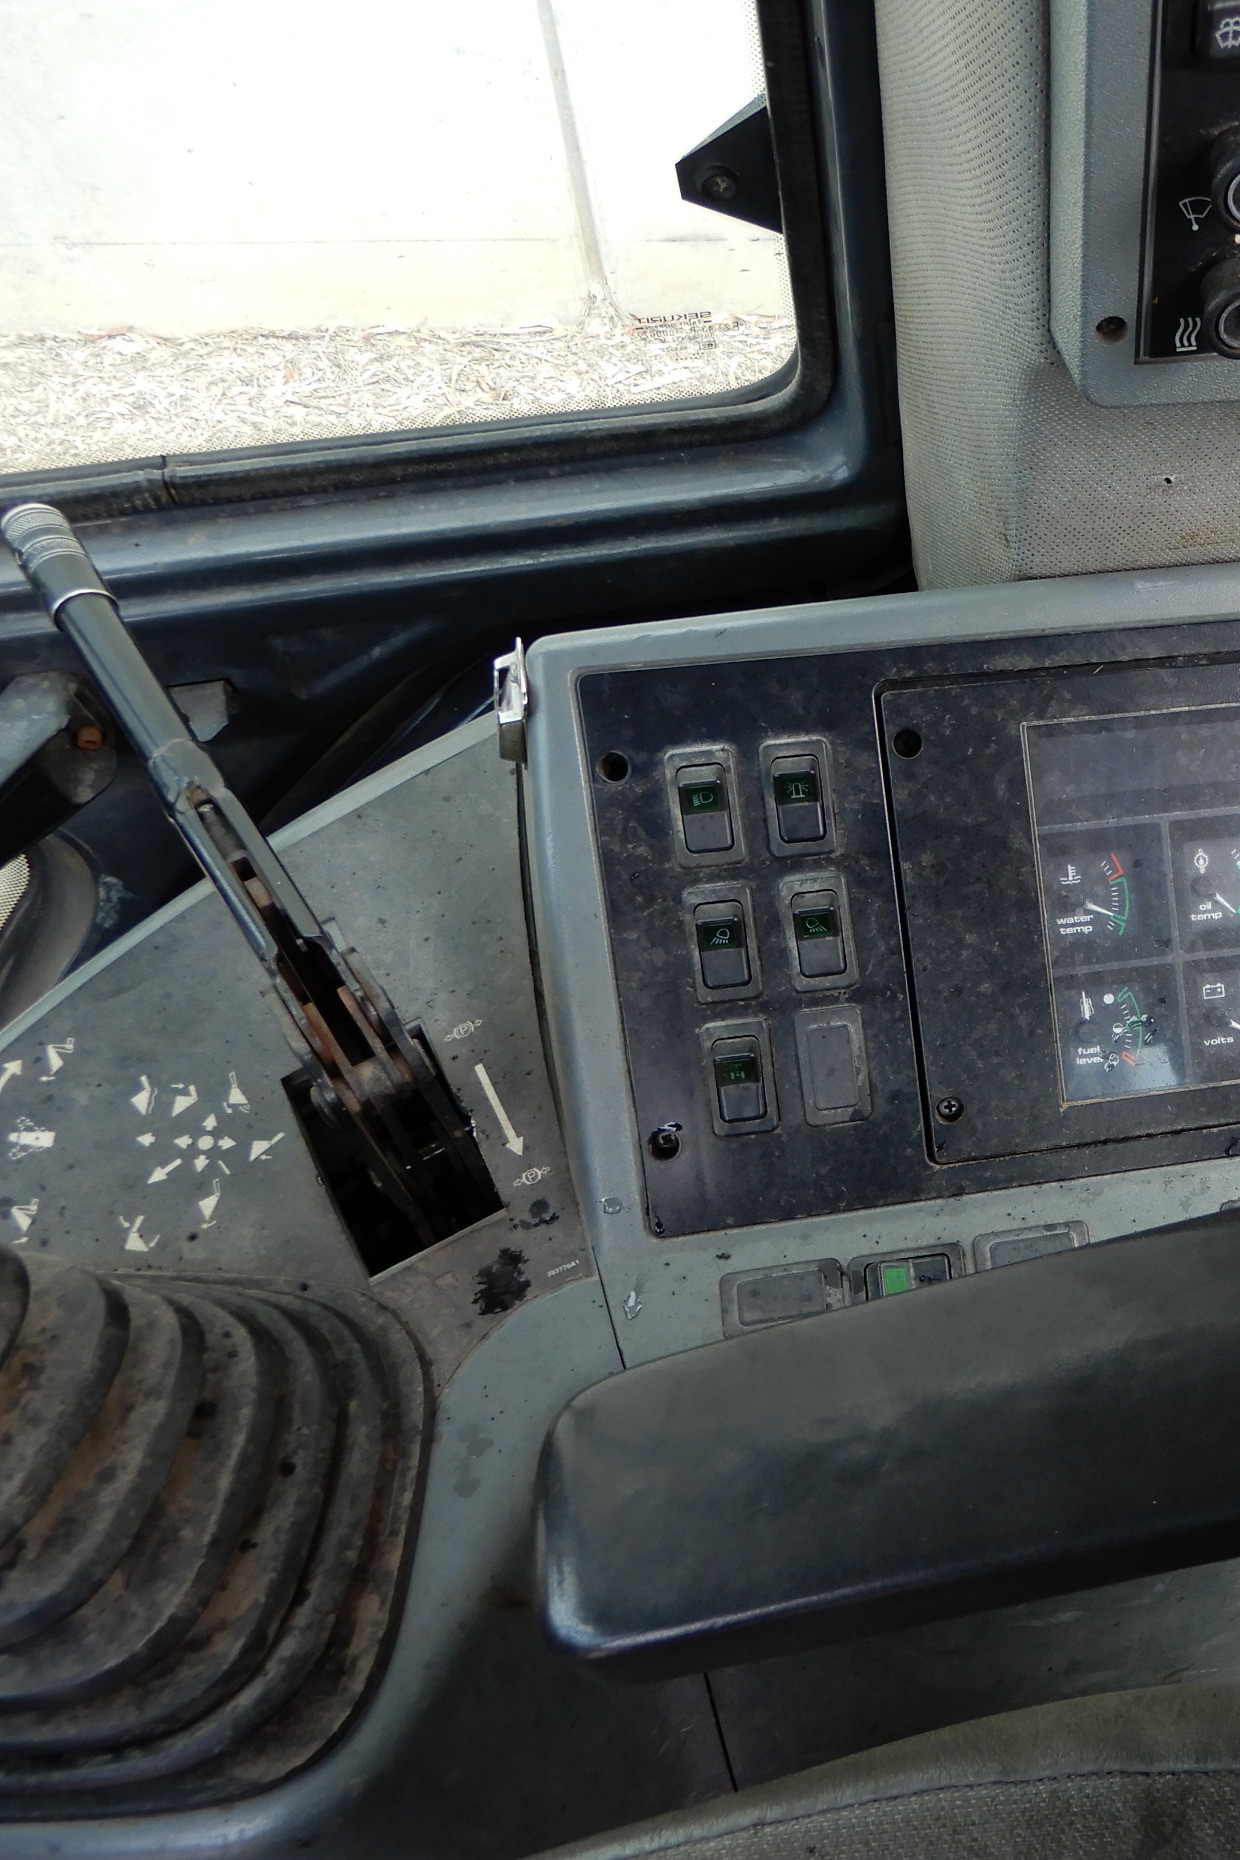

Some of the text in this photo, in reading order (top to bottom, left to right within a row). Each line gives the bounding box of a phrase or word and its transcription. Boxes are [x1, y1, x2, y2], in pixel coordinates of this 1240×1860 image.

[1199, 902, 1212, 911] oil
[1056, 914, 1094, 925] water
[1191, 911, 1222, 922] temp
[1059, 925, 1093, 935] temp
[1203, 1035, 1234, 1046] volts
[1077, 1045, 1101, 1055] fuel
